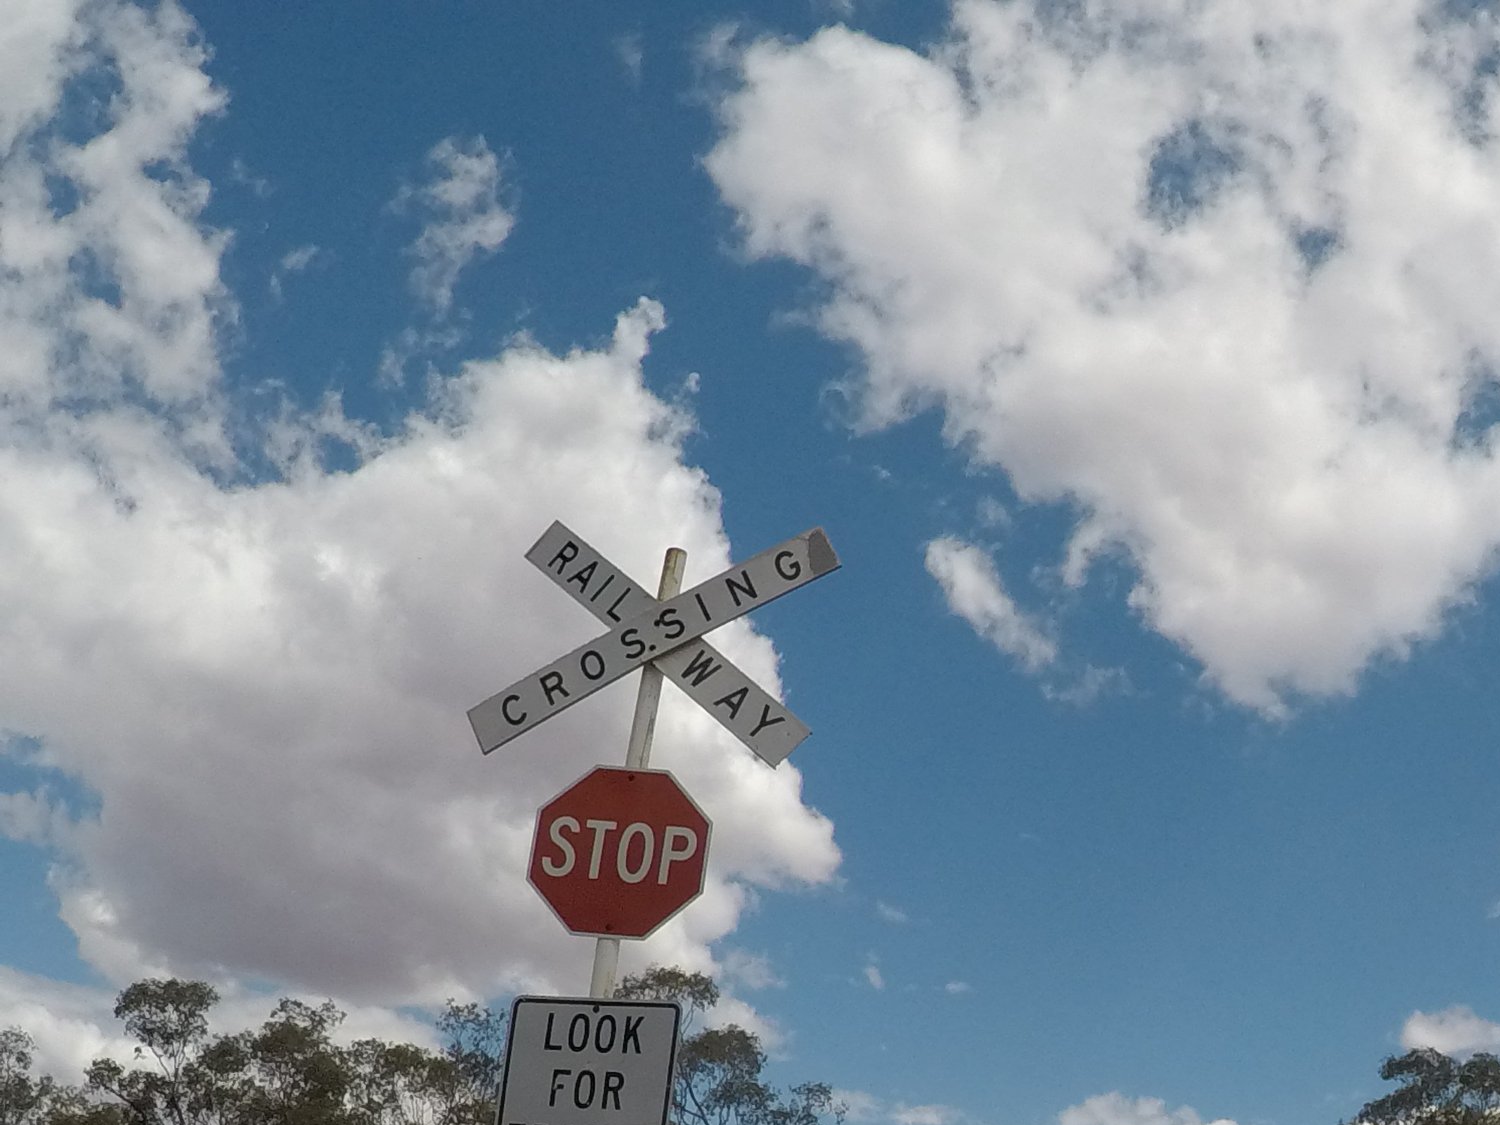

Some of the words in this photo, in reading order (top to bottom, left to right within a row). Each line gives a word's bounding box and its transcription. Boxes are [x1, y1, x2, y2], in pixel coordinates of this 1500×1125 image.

[501, 550, 802, 727] CROSSING
[548, 540, 631, 623] RAIL
[681, 649, 785, 738] WAY
[541, 815, 698, 885] STOP
[543, 1012, 645, 1055] LOOK
[548, 1069, 625, 1110] FOR
